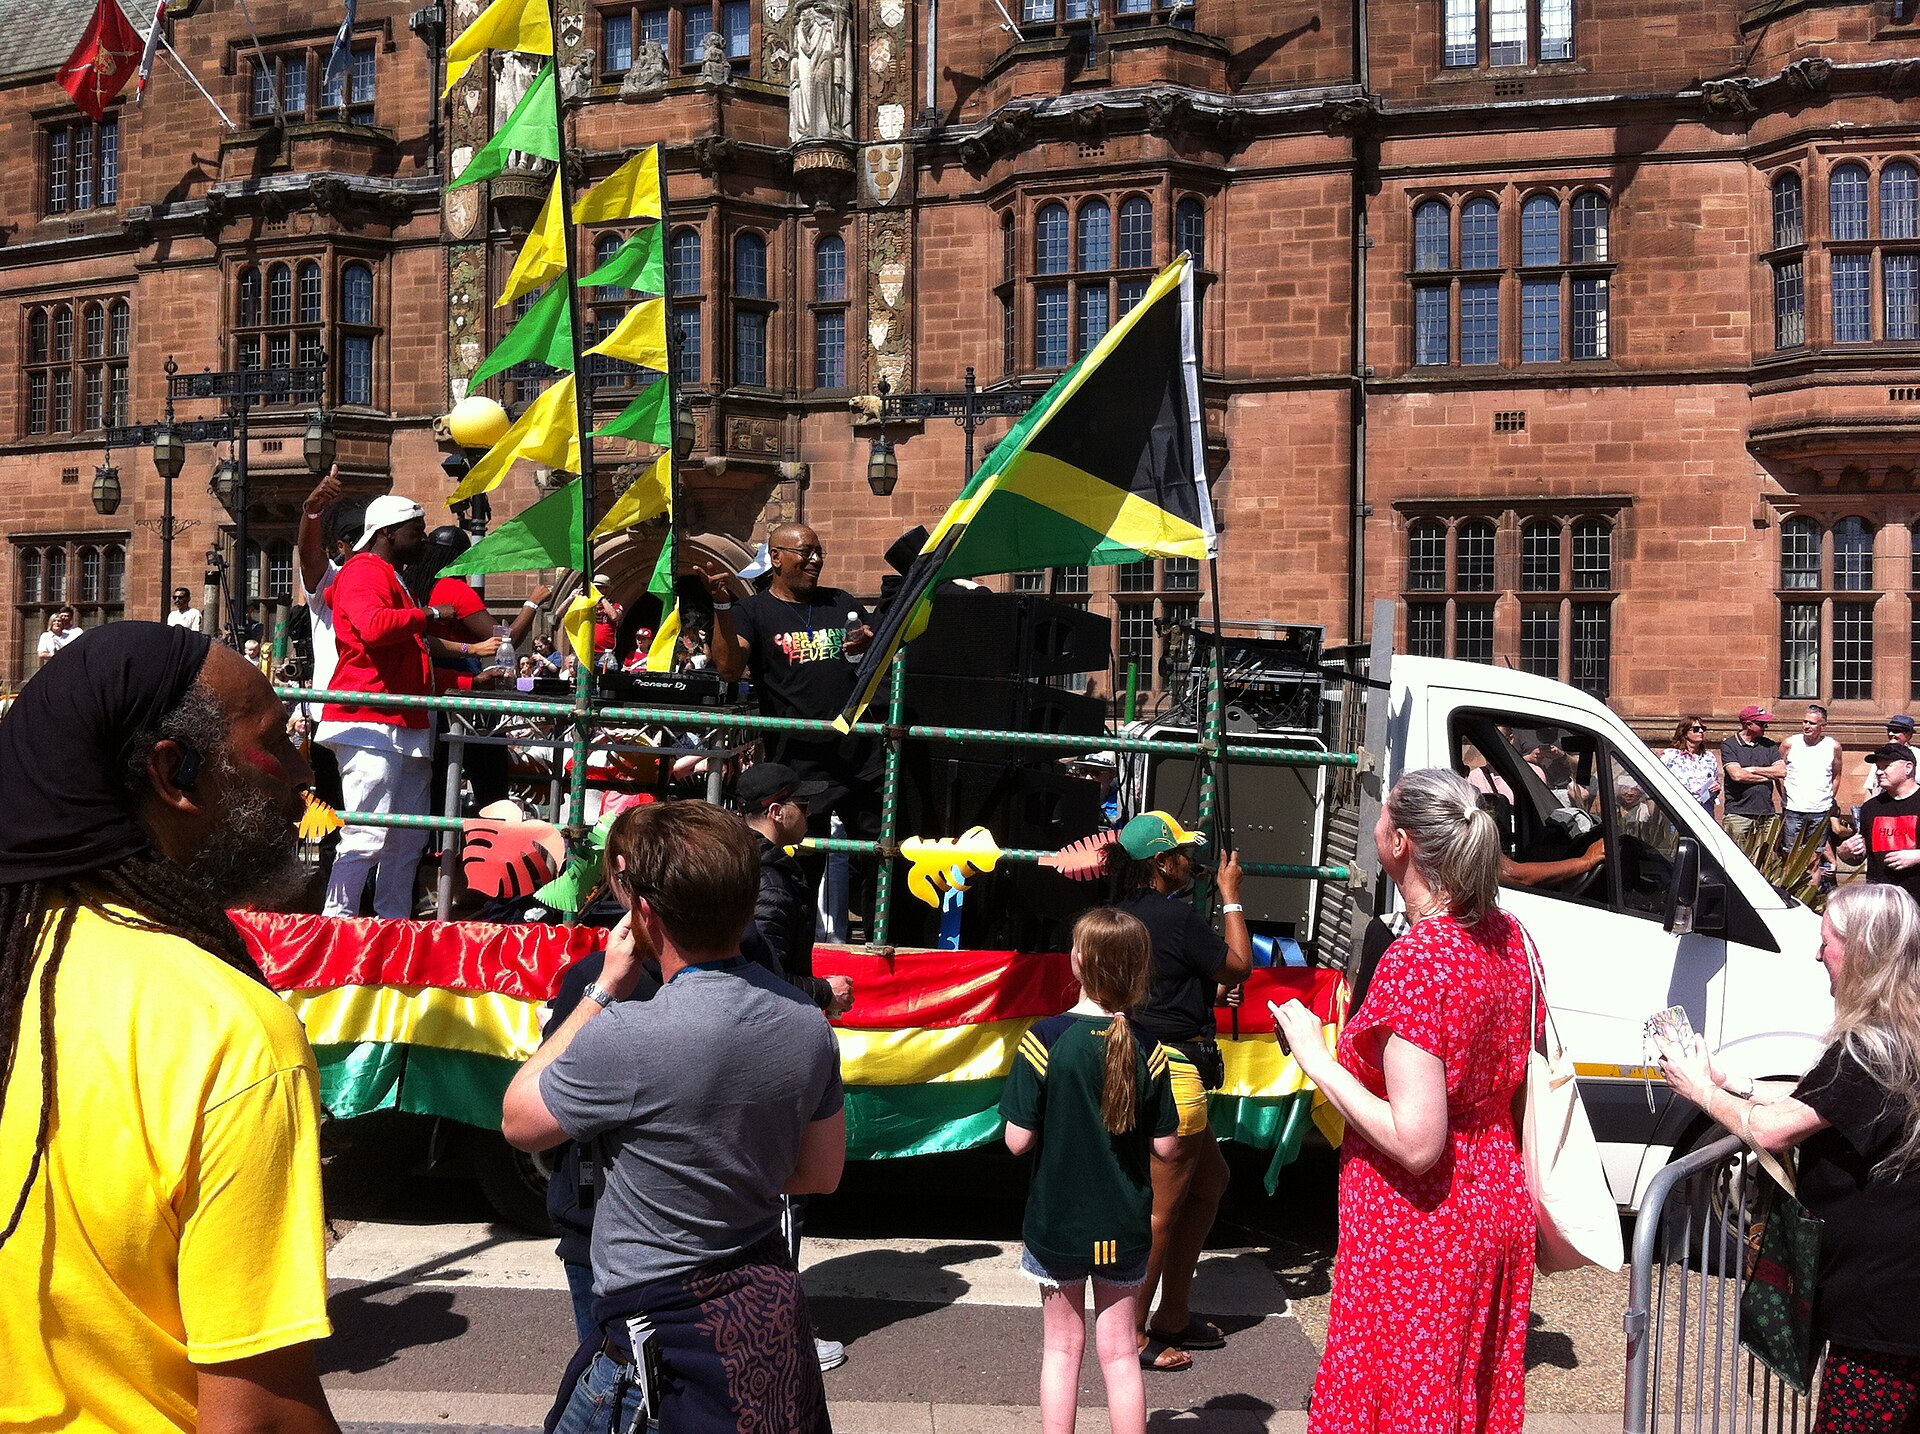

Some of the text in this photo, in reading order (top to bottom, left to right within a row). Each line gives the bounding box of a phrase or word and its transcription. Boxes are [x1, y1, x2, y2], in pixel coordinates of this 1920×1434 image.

[783, 636, 842, 654] REGGAE
[789, 645, 841, 666] FEVER
[633, 678, 673, 688] Pioneer
[1878, 827, 1908, 838] HUGO
